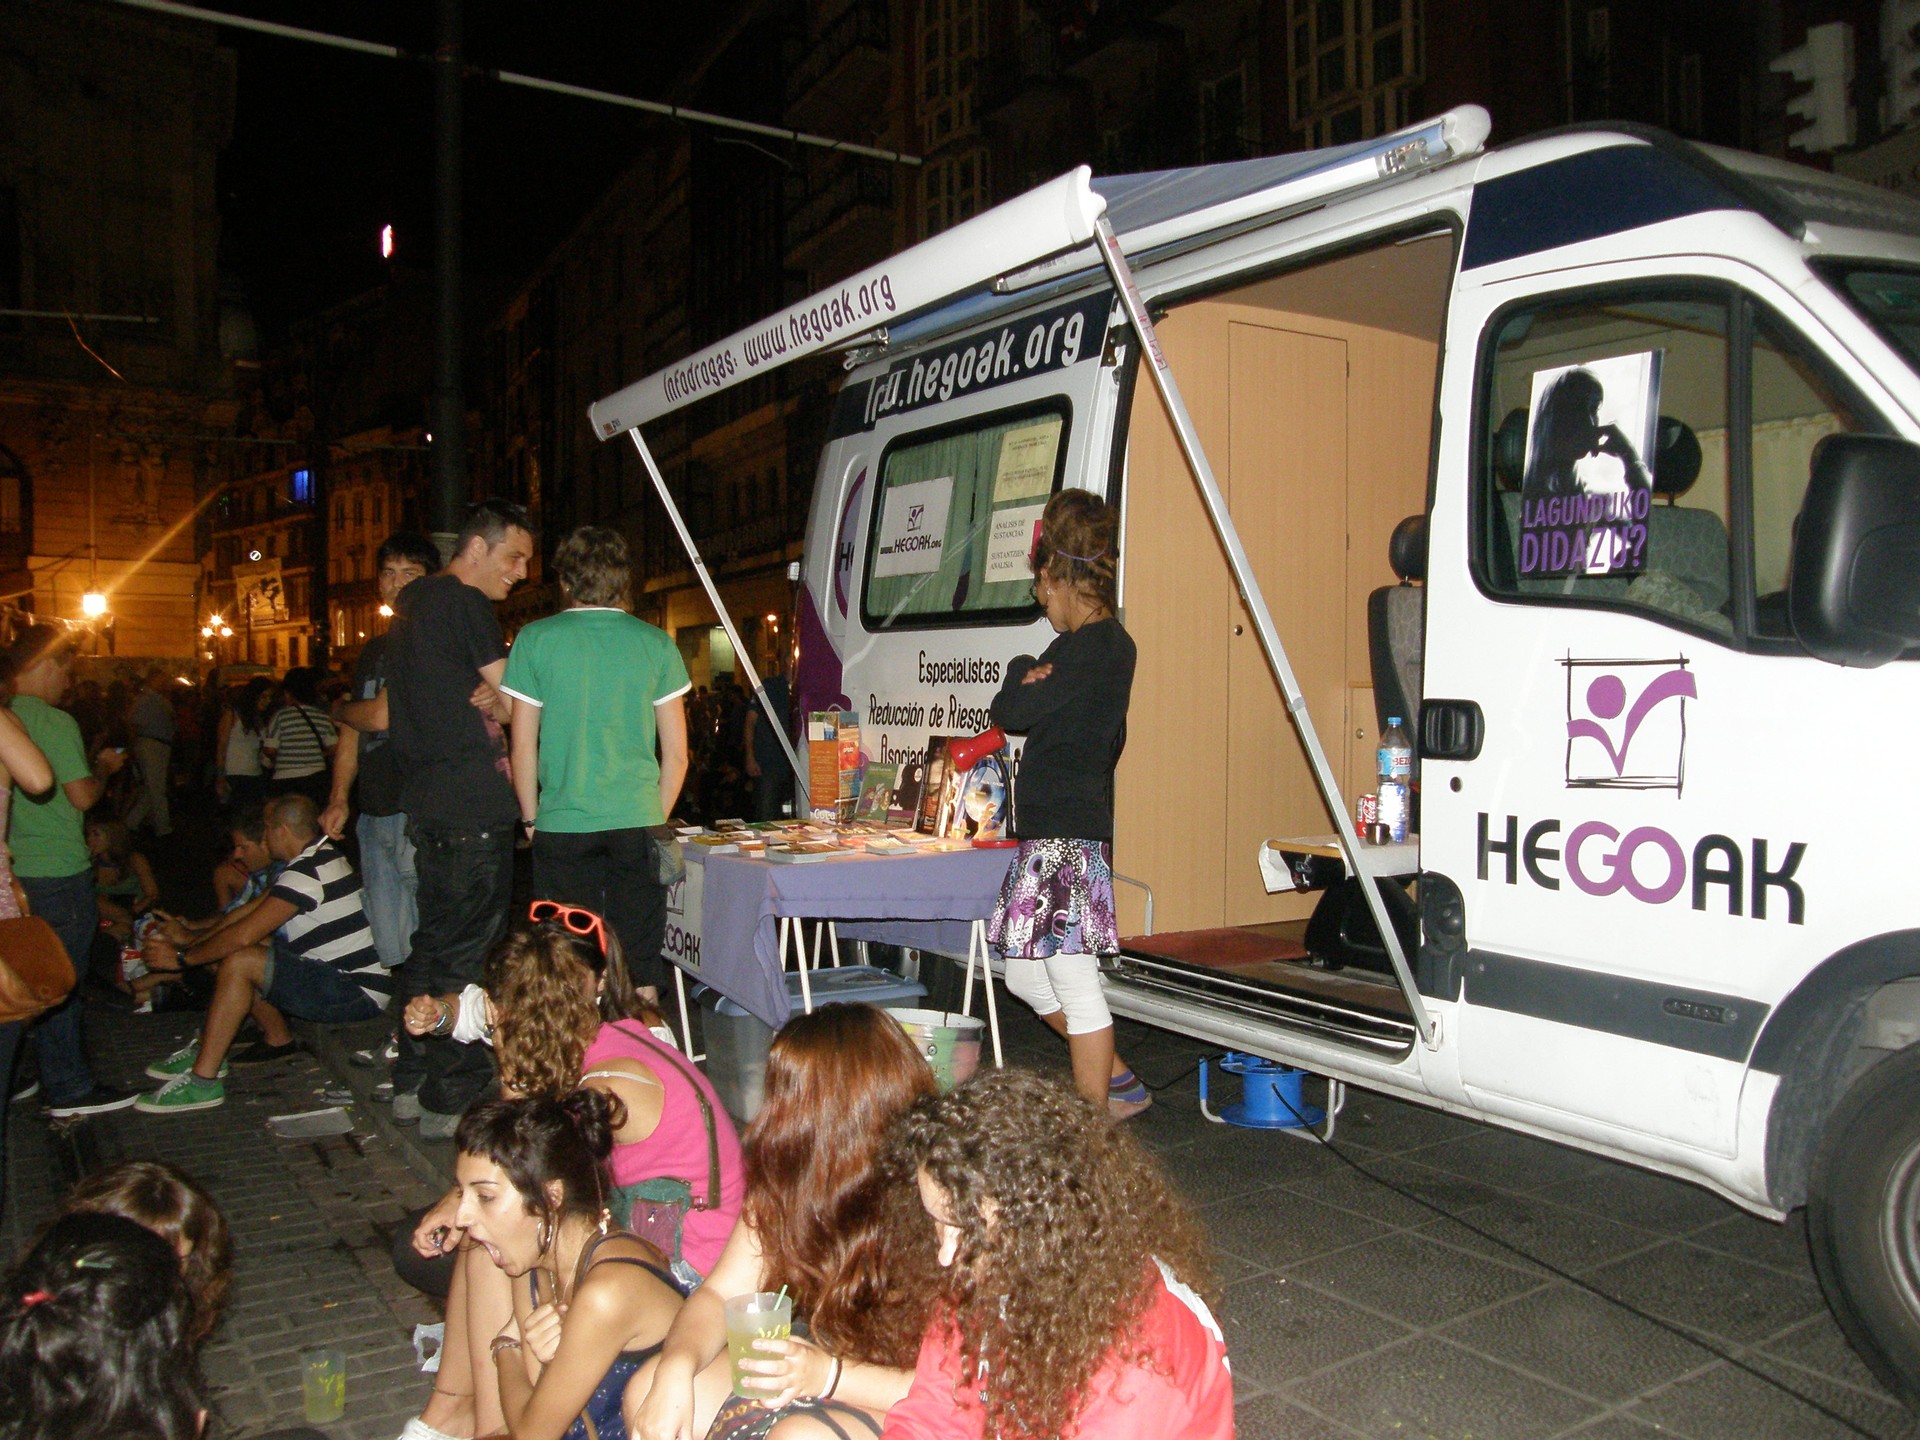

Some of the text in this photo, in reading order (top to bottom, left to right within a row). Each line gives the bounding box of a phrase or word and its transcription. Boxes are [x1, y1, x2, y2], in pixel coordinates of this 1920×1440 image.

[663, 274, 896, 403] Infodrogas: www.hegoak.org
[1523, 488, 1649, 528] LAGUNDUKO
[1521, 524, 1647, 573] DIDAZU?
[918, 650, 1000, 687] Especialistas
[868, 693, 993, 734] Reducción de Riesgo
[1476, 811, 1809, 926] HEGOAK
[662, 923, 701, 967] GOAK
